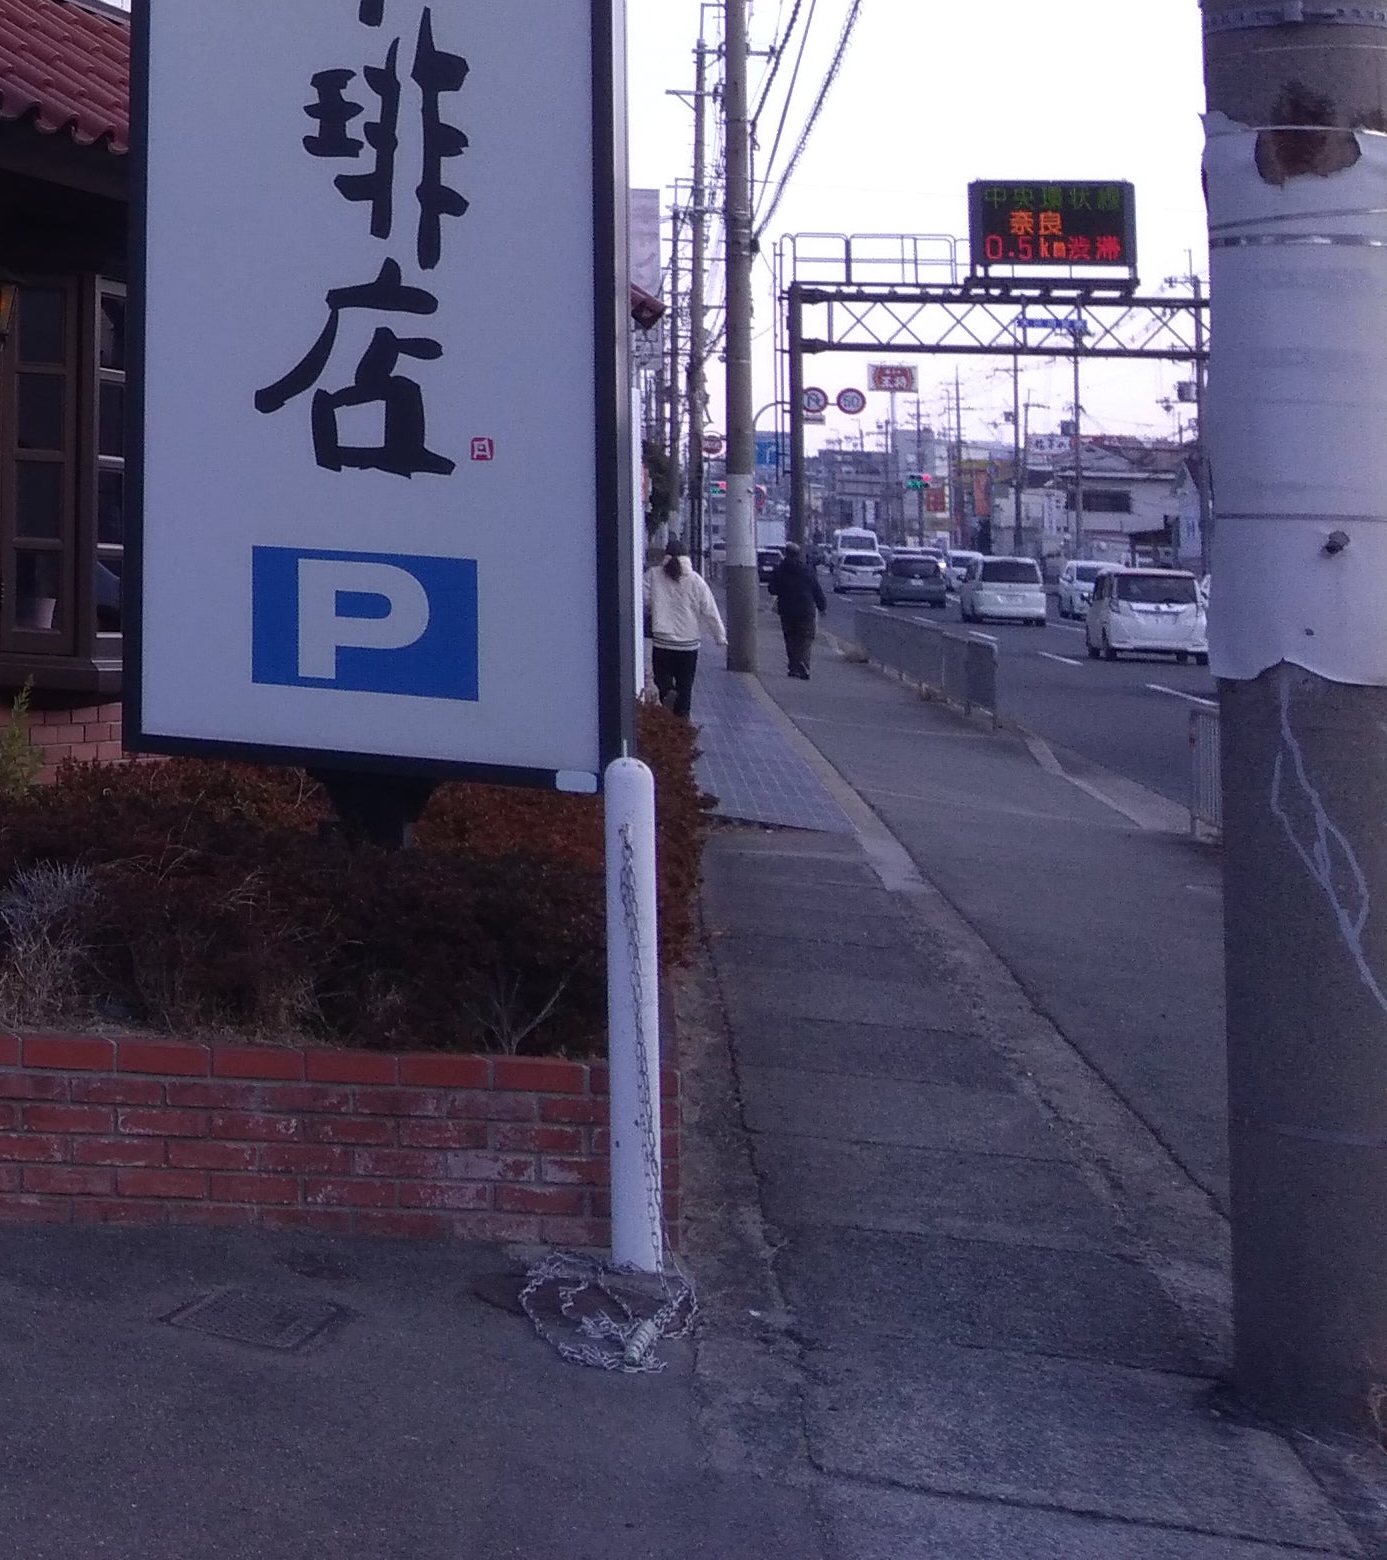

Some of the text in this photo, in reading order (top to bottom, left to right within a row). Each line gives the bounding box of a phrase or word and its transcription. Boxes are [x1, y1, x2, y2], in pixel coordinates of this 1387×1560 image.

[1008, 210, 1063, 236] 奈良
[843, 395, 860, 408] 50
[298, 558, 429, 680] P
